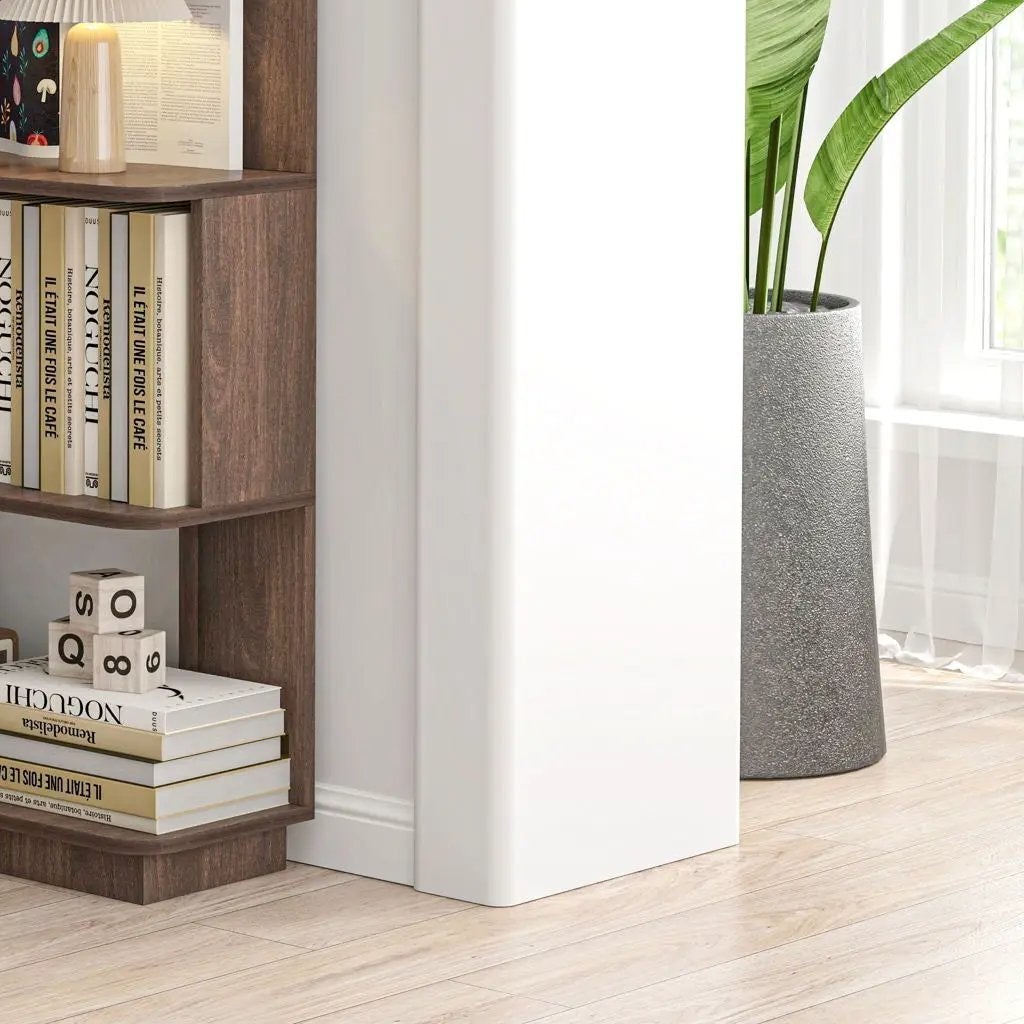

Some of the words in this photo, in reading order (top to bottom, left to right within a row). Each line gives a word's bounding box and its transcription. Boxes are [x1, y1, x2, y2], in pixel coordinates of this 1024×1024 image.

[133, 286, 146, 297] IL
[133, 302, 148, 336] ÉTAIT
[85, 264, 98, 424] NOGUCHI
[133, 339, 146, 366] UNE
[133, 368, 146, 397] FOIS
[133, 400, 146, 415] LE
[133, 418, 148, 451] CAFÉ
[57, 633, 85, 668] Q
[103, 655, 131, 676] 8
[6, 684, 122, 725] NOGUCHI
[22, 717, 96, 744] Remodelista
[9, 767, 20, 783] LE
[23, 769, 43, 788] FOIS
[45, 774, 63, 791] UNE
[65, 779, 91, 801] ÉTAIT
[93, 784, 102, 800] IL
